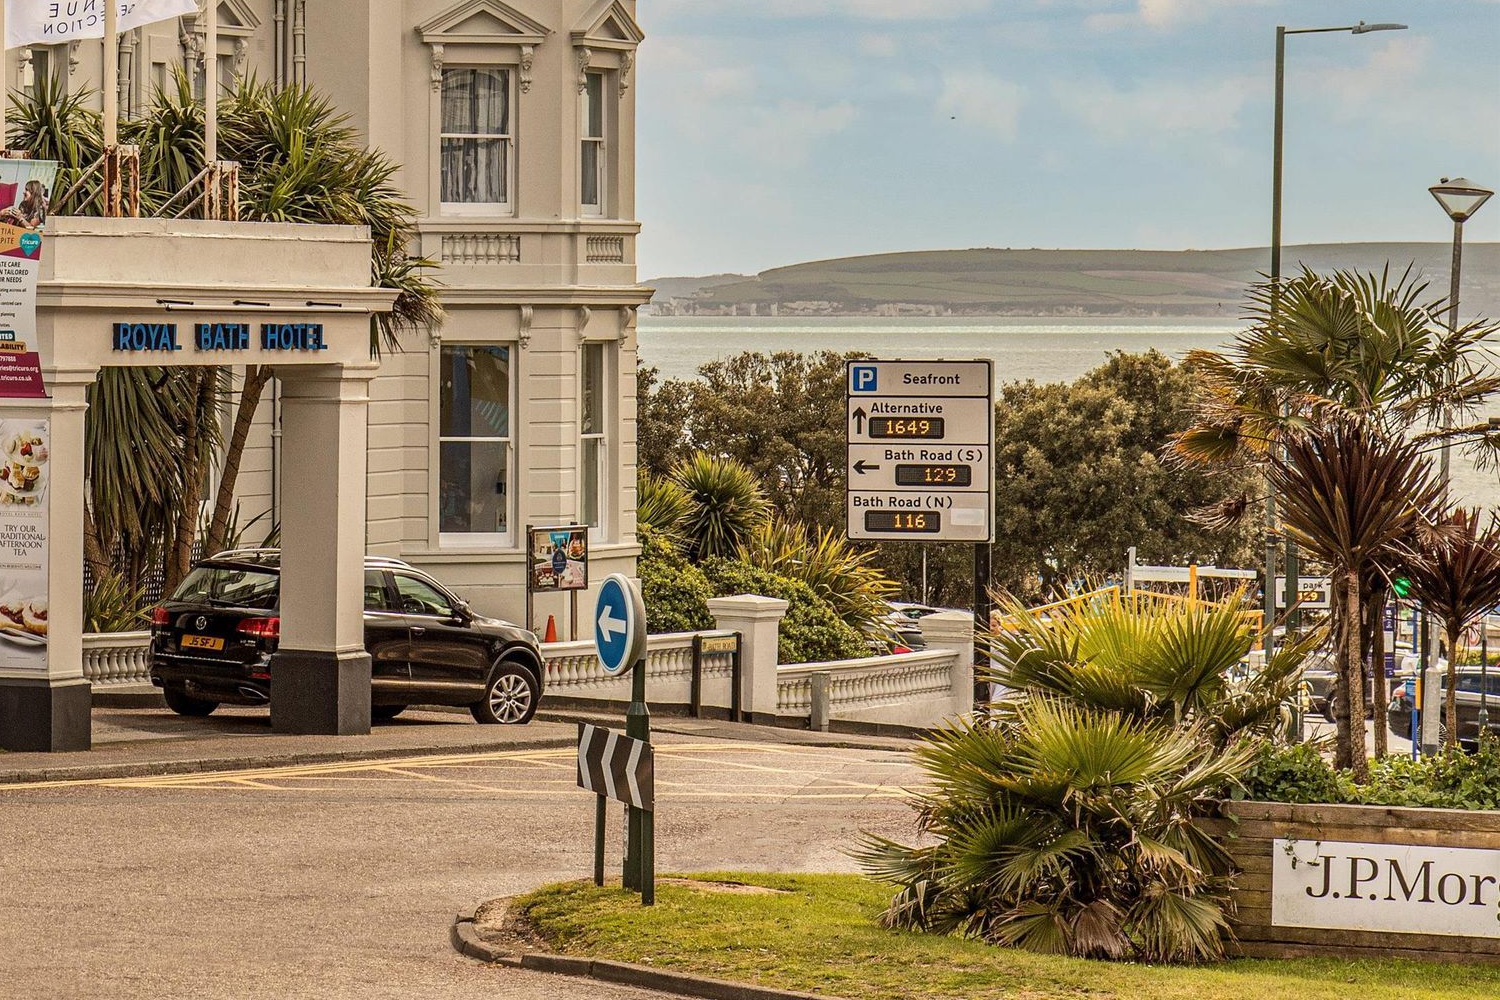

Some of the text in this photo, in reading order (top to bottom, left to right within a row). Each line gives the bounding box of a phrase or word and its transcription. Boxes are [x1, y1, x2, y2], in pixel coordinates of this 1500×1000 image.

[113, 323, 327, 350] ROYAL BATH HOTEL
[859, 369, 873, 389] P
[903, 373, 960, 385] Seafront
[871, 402, 943, 413] Alternative
[886, 420, 930, 434] 1649
[884, 450, 983, 462] Bath Road (S)
[925, 468, 956, 482] 129
[853, 496, 953, 508] Bath Road (N)
[894, 514, 925, 528] 116
[1303, 581, 1323, 589] park
[200, 637, 216, 648] SFJ
[1306, 855, 1500, 921] J.P.Mor
